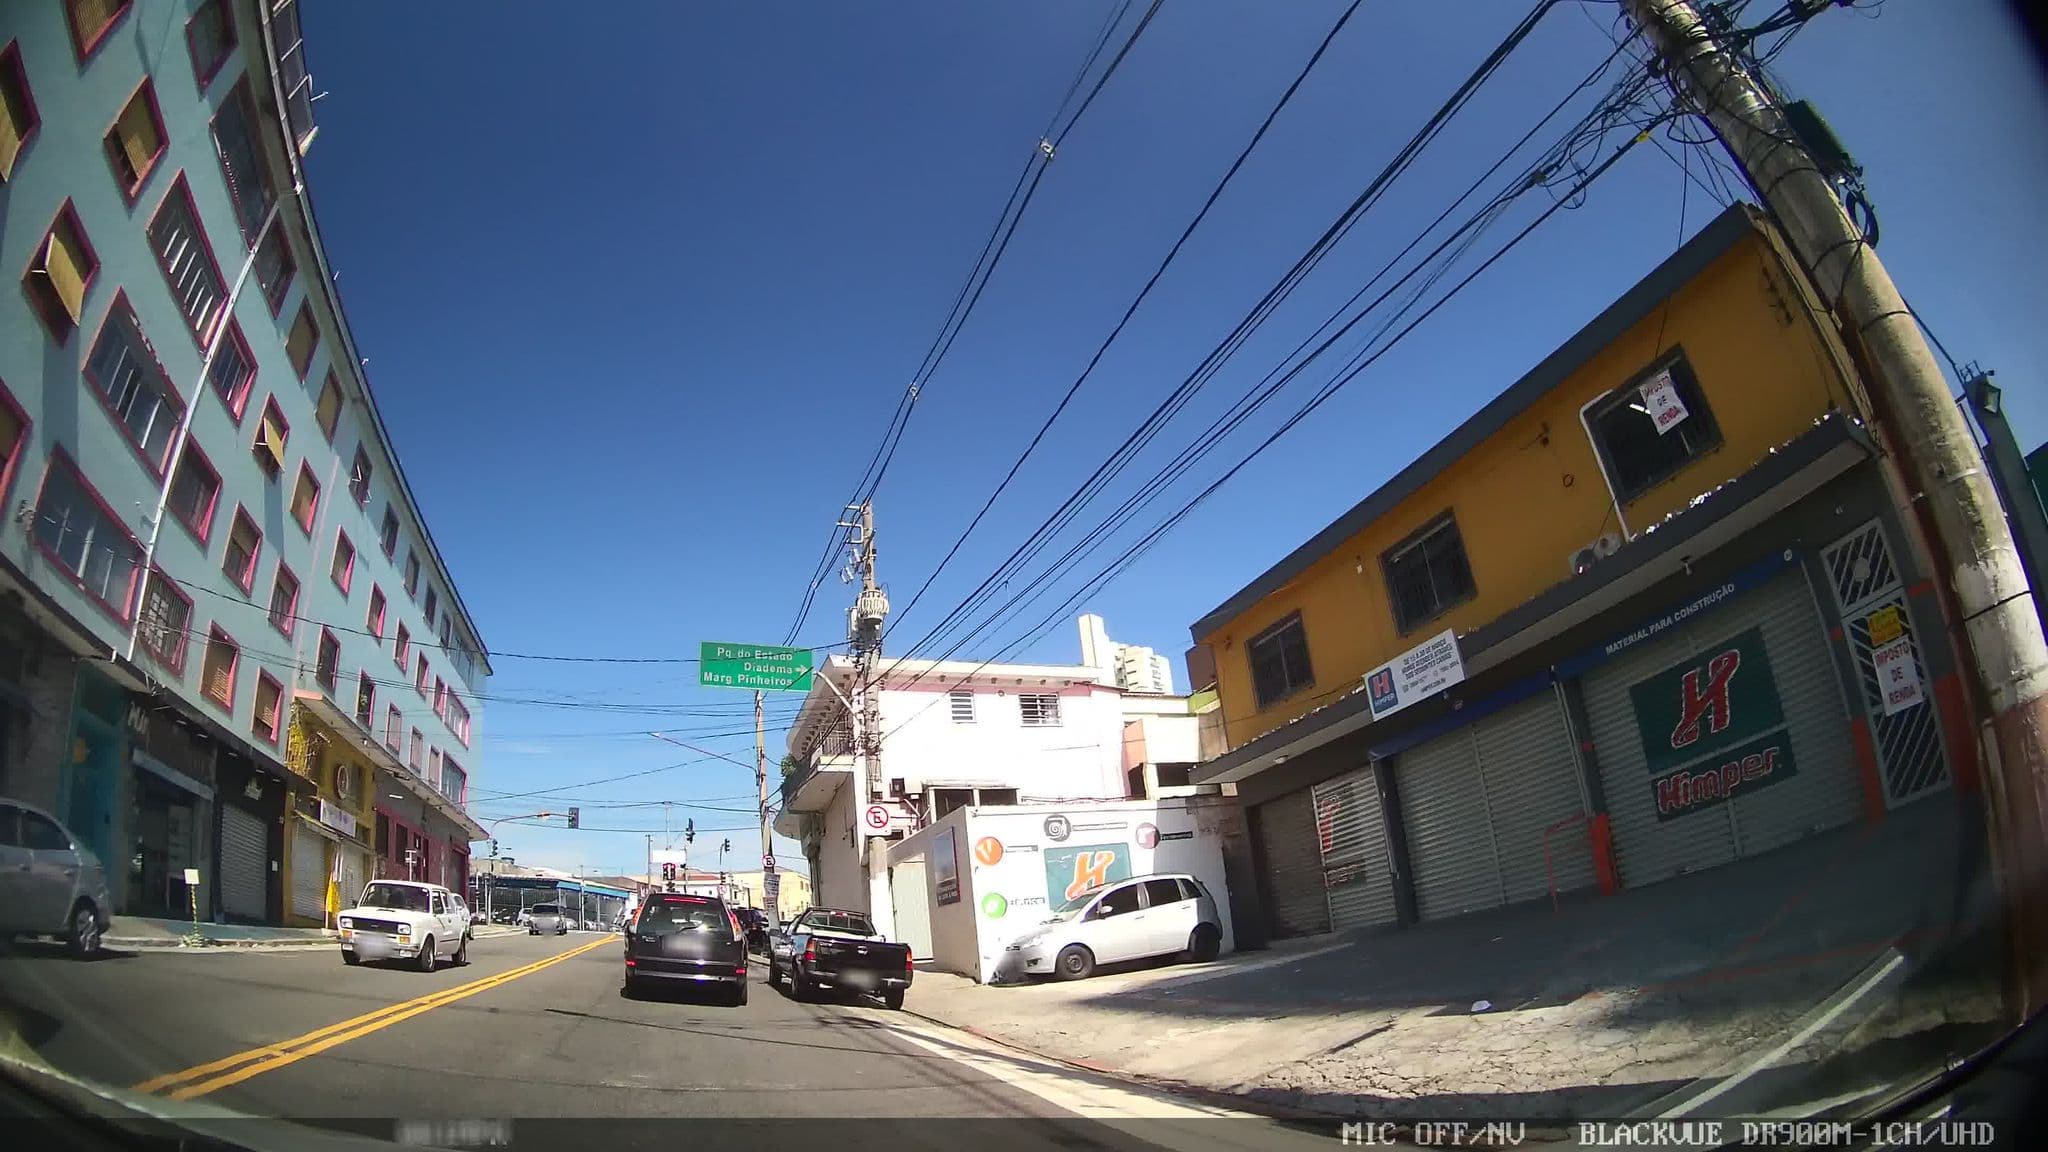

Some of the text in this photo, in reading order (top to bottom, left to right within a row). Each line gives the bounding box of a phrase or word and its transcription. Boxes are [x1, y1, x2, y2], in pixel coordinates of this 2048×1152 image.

[1605, 583, 1735, 656] MATERIAL PARA CONSTRUÇÃO
[717, 647, 793, 661] Pq do Estado
[744, 662, 793, 674] Diadema
[1891, 666, 1904, 682] DE
[703, 671, 793, 686] Marg Pinheiros
[1657, 746, 1779, 815] Himper
